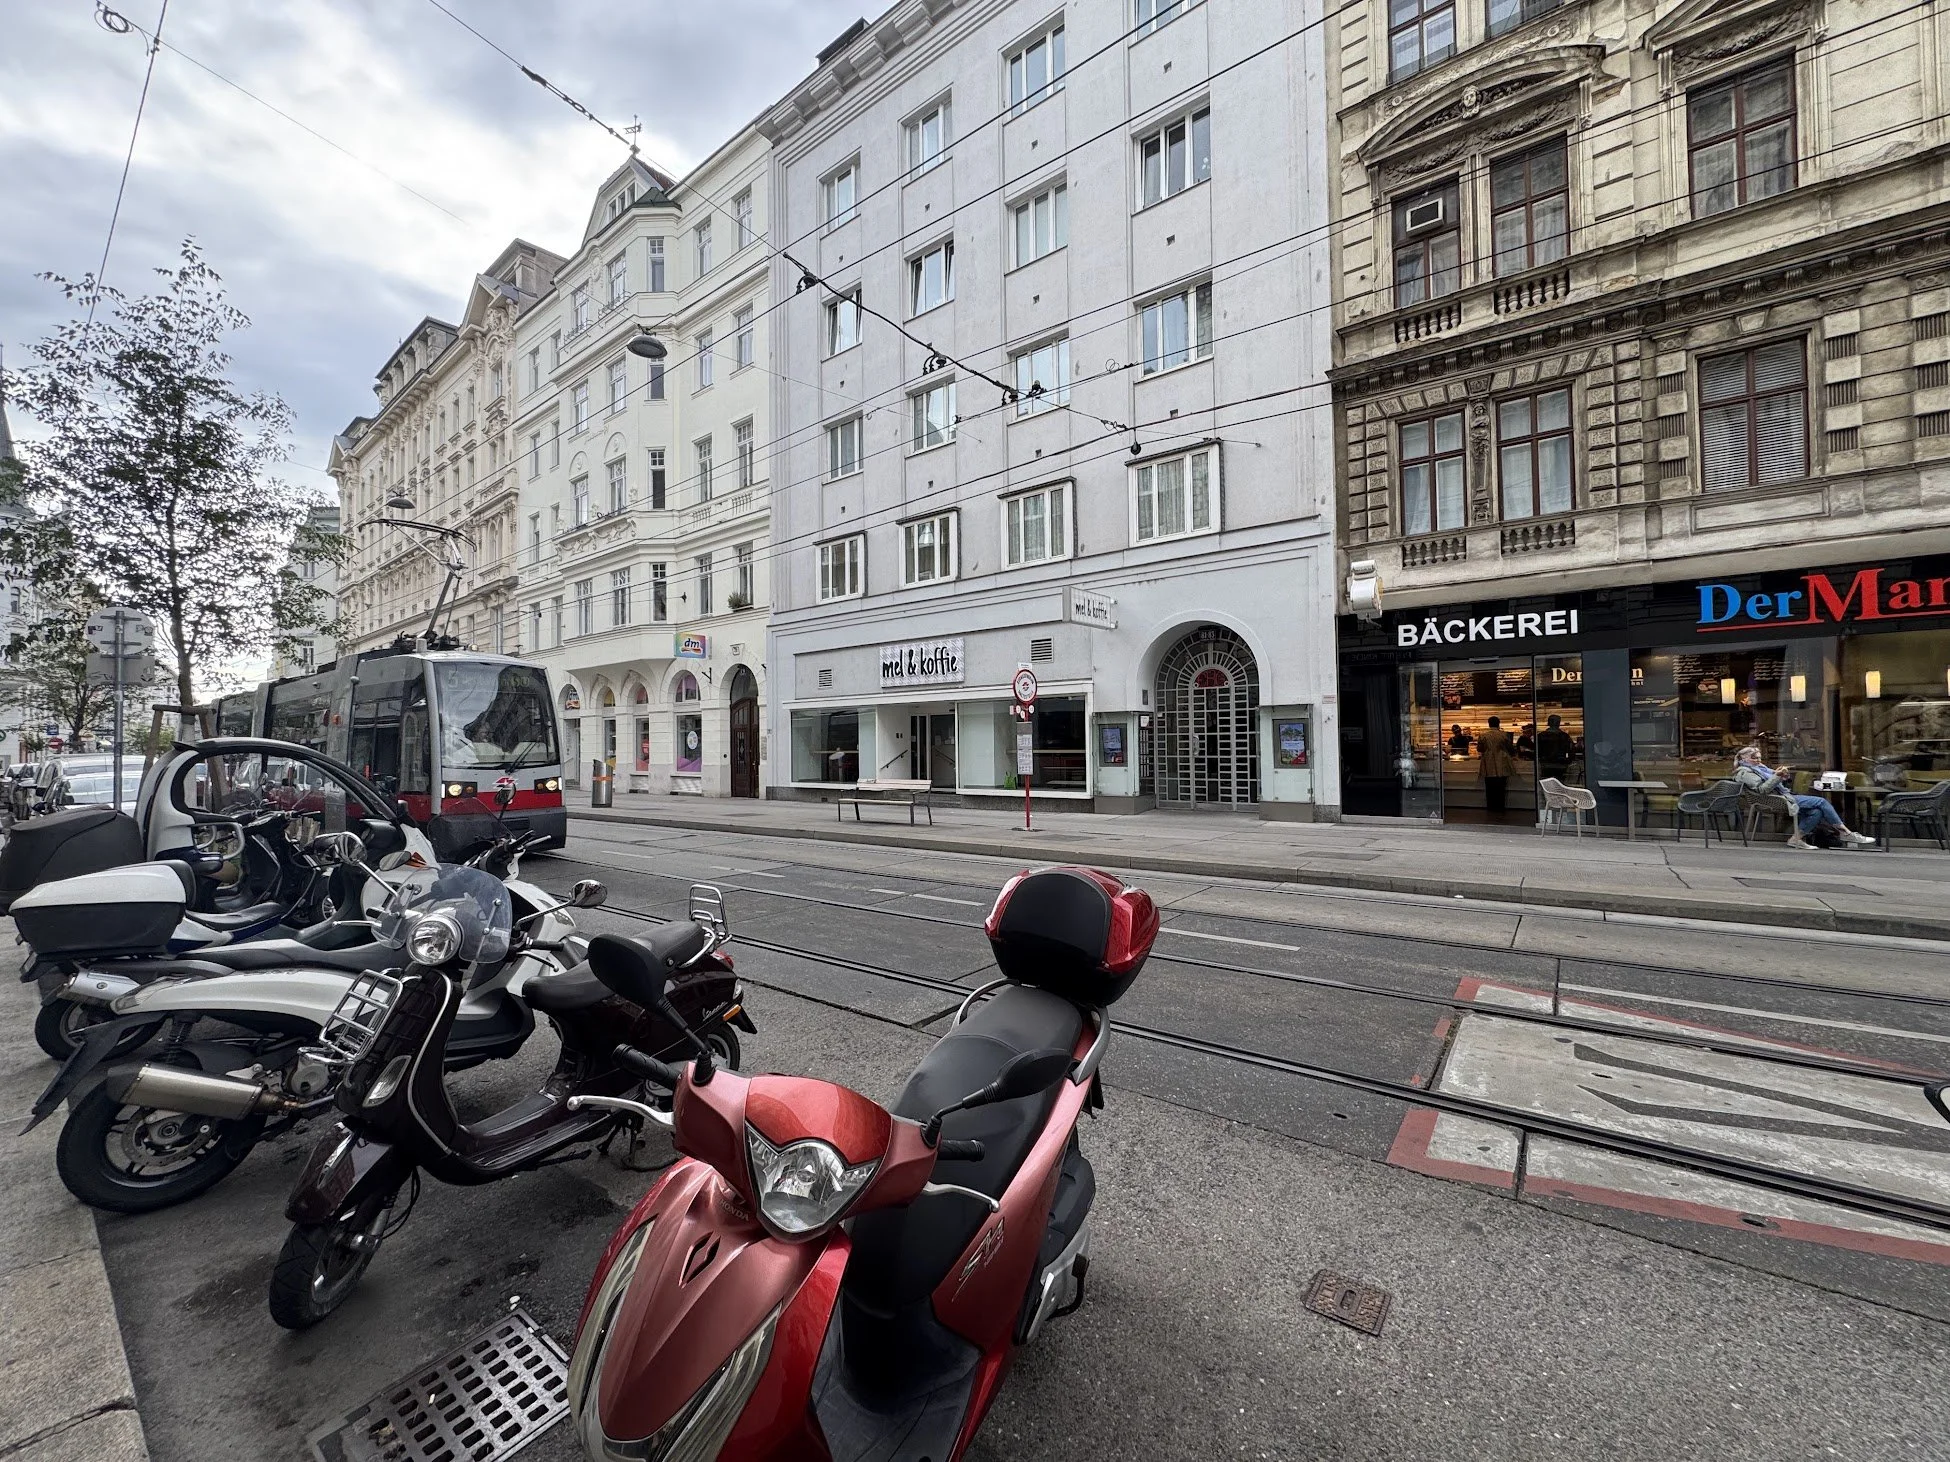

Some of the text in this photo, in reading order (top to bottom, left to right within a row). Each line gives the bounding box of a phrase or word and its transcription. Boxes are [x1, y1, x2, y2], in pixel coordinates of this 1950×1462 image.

[1075, 597, 1086, 616] mel
[1397, 609, 1579, 647] BÄCKEREI
[684, 637, 700, 649] dm
[882, 646, 958, 678] mel & koffie
[720, 1199, 749, 1222] HONDA
